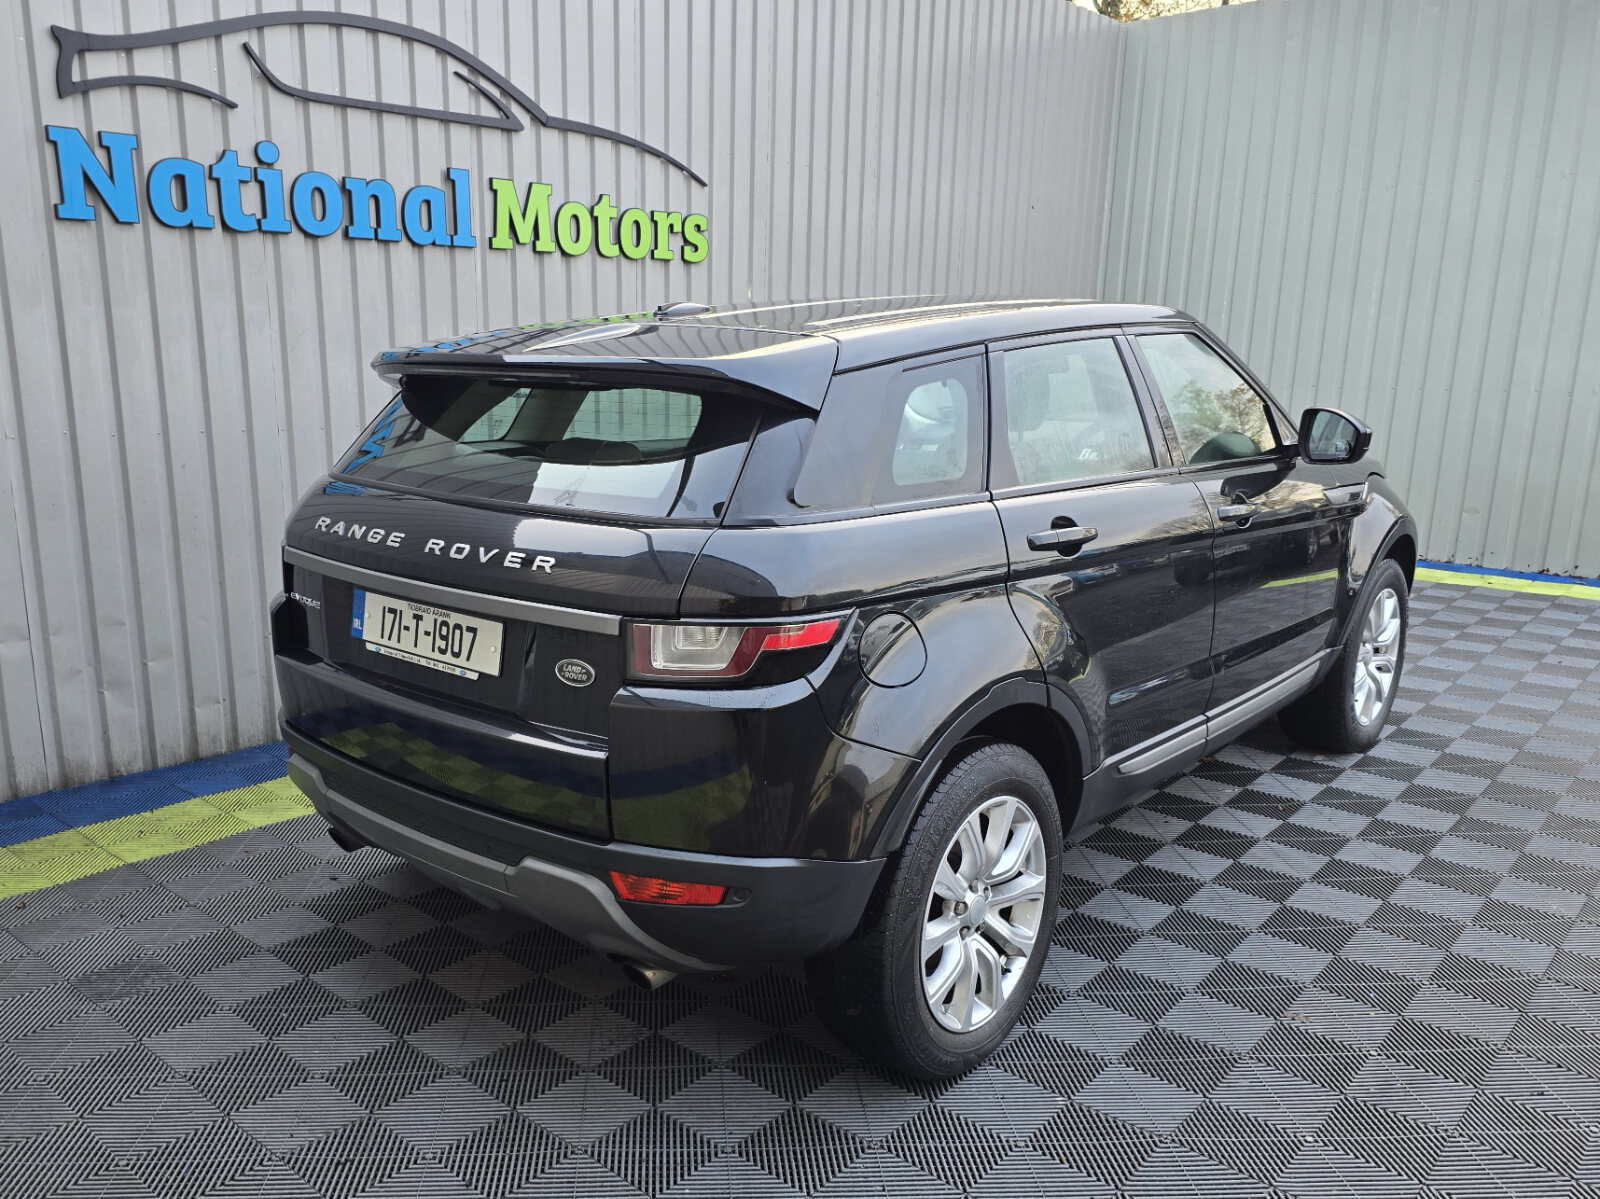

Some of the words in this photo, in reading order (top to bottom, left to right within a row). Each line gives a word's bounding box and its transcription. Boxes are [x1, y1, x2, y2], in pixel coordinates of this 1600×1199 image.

[45, 124, 478, 248] National
[488, 176, 710, 264] Motors
[314, 516, 406, 548] RANGE
[424, 538, 556, 574] ROVER
[380, 605, 479, 663] 171-T-1907
